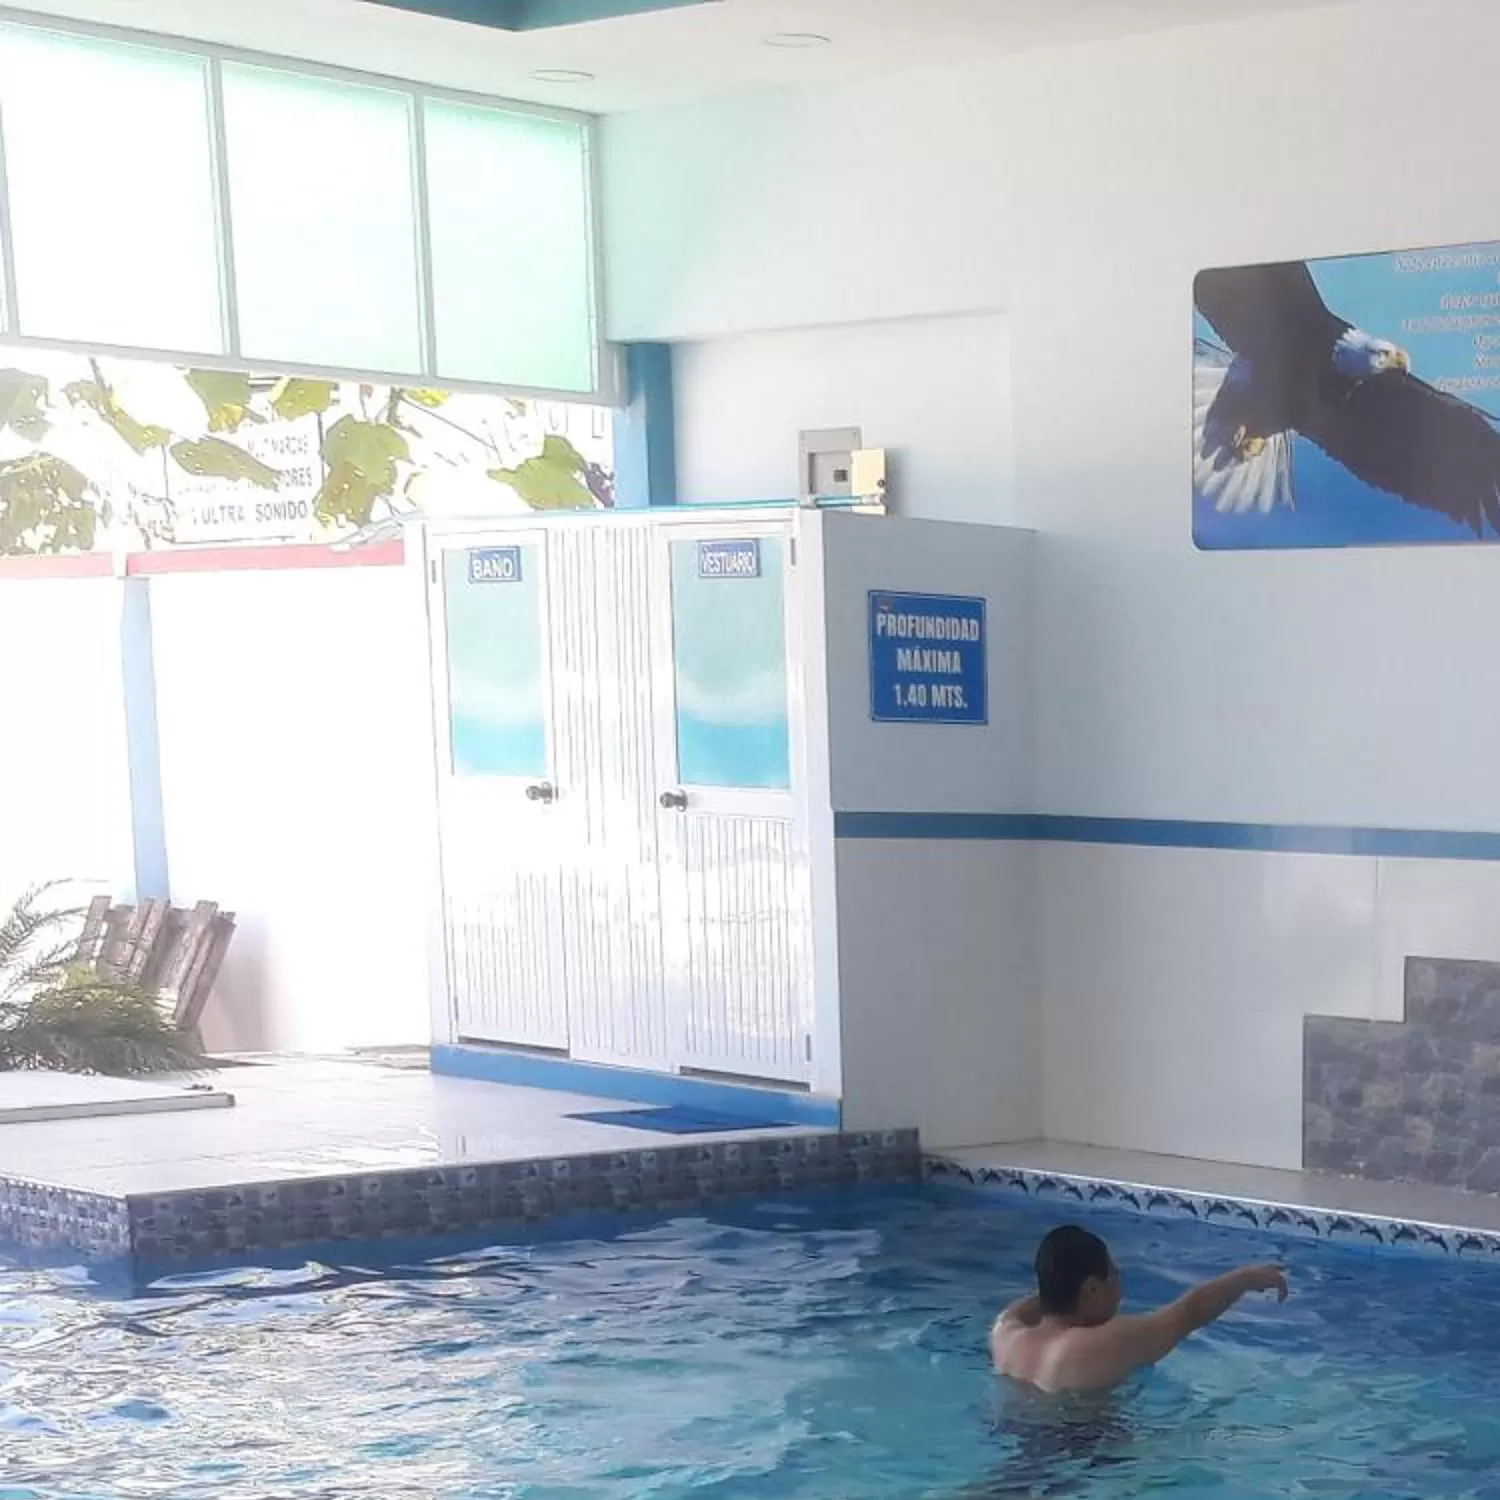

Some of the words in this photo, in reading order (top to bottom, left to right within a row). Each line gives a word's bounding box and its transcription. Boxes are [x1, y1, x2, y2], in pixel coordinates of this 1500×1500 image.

[255, 500, 308, 523] SONIDO
[876, 613, 979, 641] PROFUNDIDAD
[896, 645, 962, 674] MÁXIMA
[893, 683, 927, 707] 1.40
[931, 685, 968, 708] MTS.
